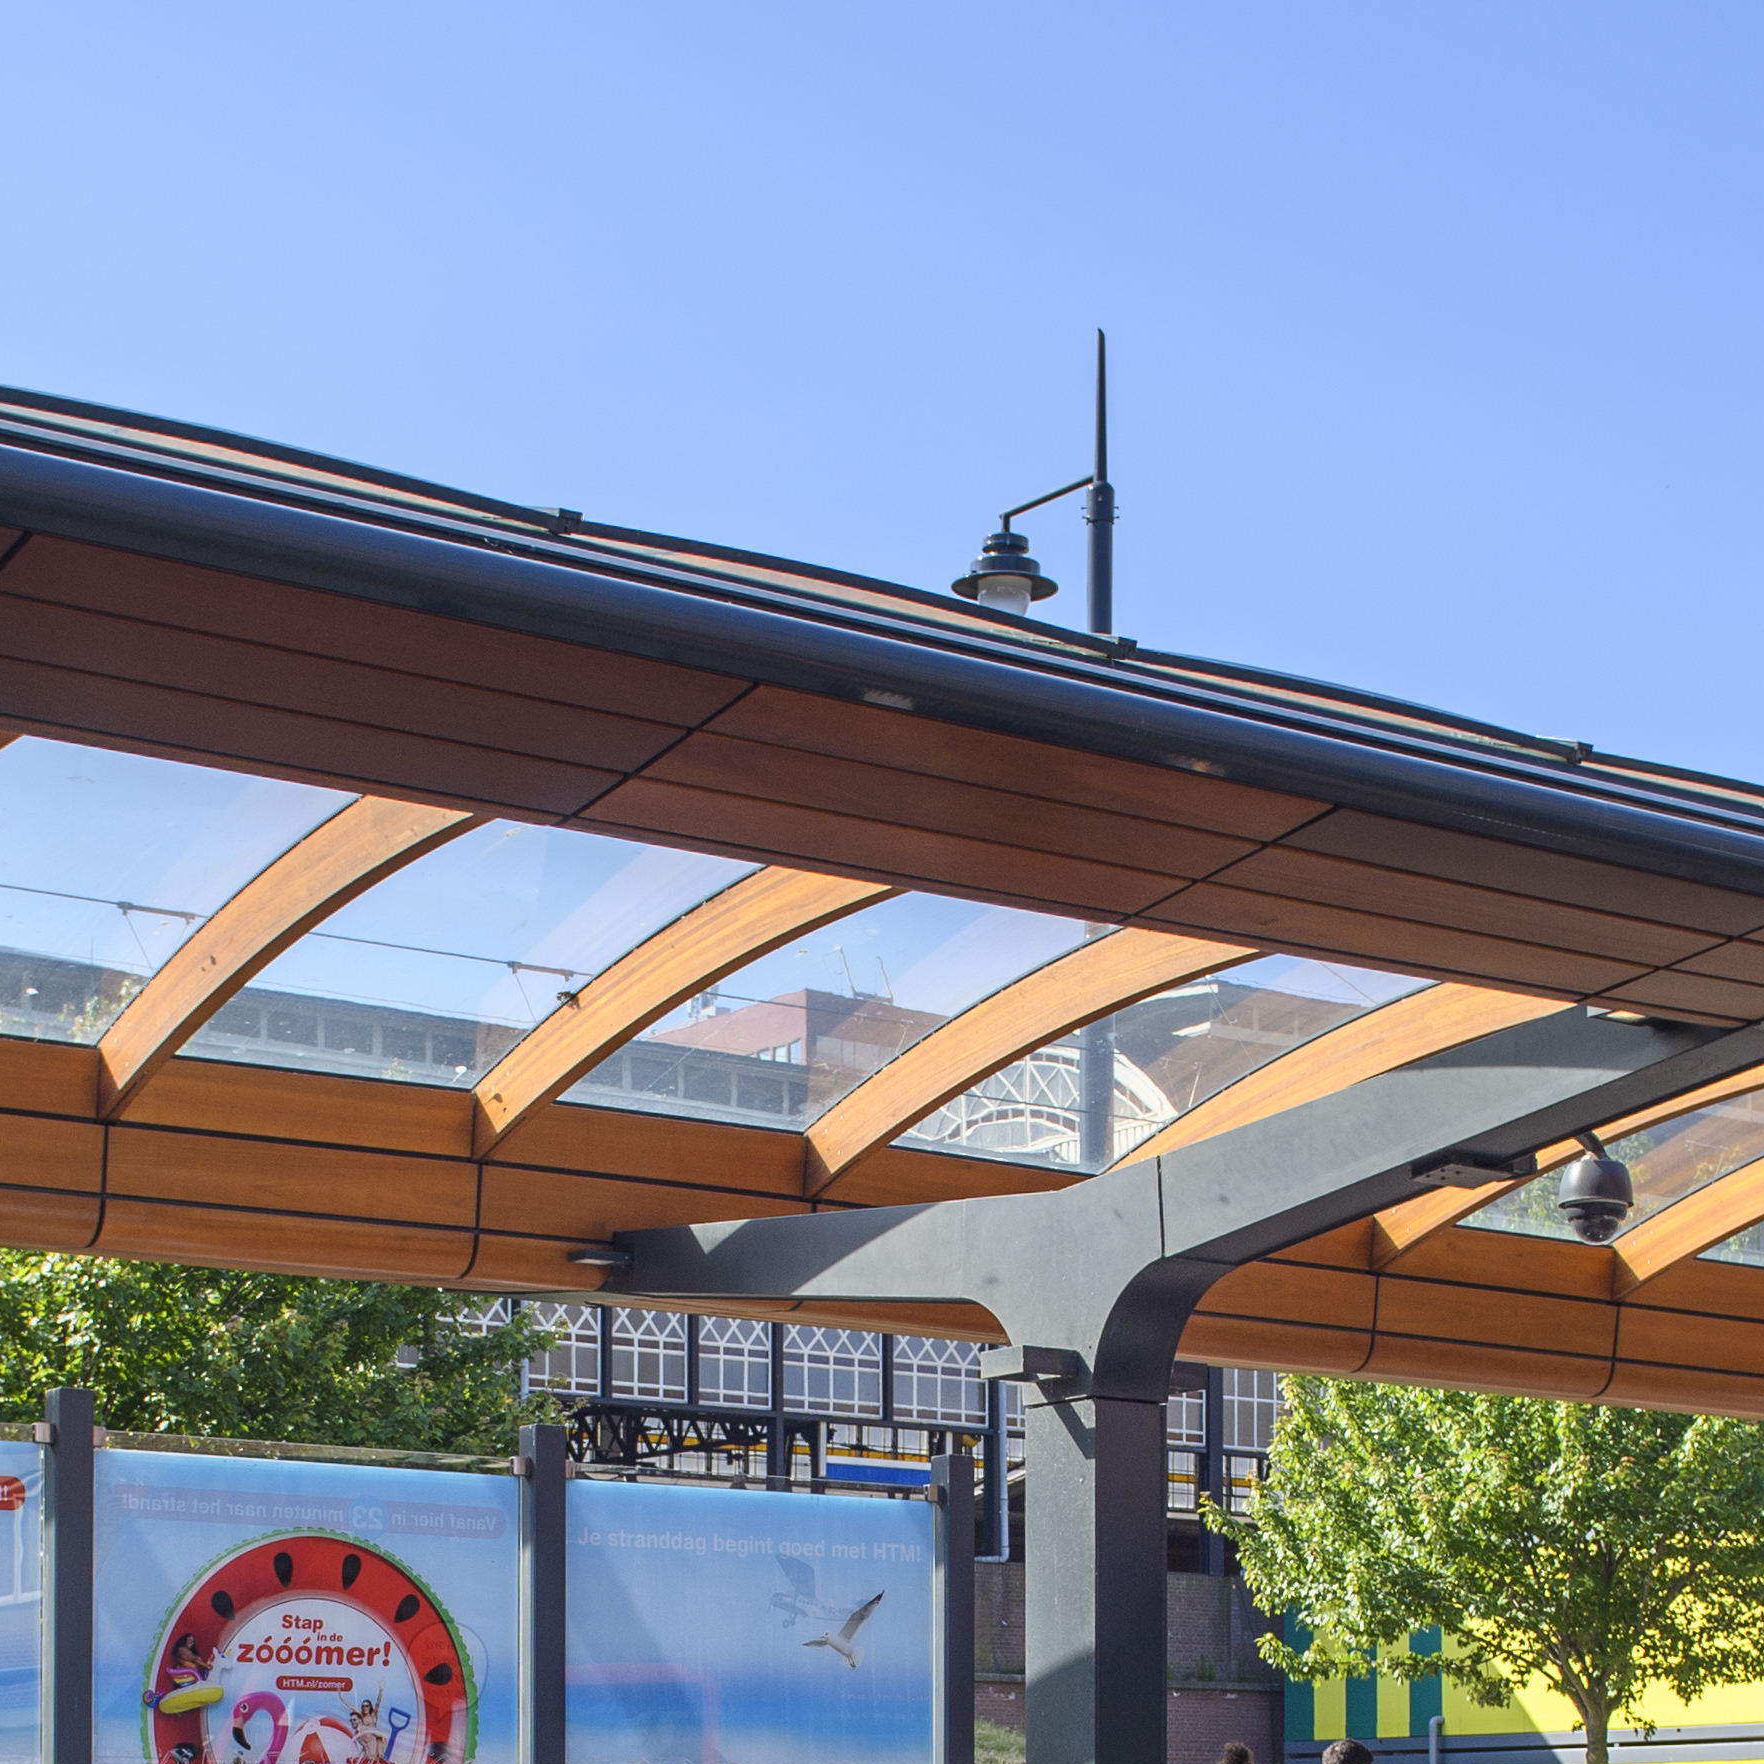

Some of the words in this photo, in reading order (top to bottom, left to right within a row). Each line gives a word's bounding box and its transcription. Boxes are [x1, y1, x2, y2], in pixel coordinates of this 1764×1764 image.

[577, 1526, 602, 1546] Je
[607, 1528, 707, 1556] stranddag
[713, 1532, 773, 1558] begint
[778, 1538, 826, 1560] goed
[831, 1542, 867, 1560] met
[873, 1542, 922, 1564] HTM!
[281, 1613, 324, 1633] Stap
[316, 1632, 327, 1642] in
[329, 1633, 344, 1642] de
[236, 1635, 391, 1667] zóóómer!
[282, 1678, 346, 1689] HTM.nl/zomer
